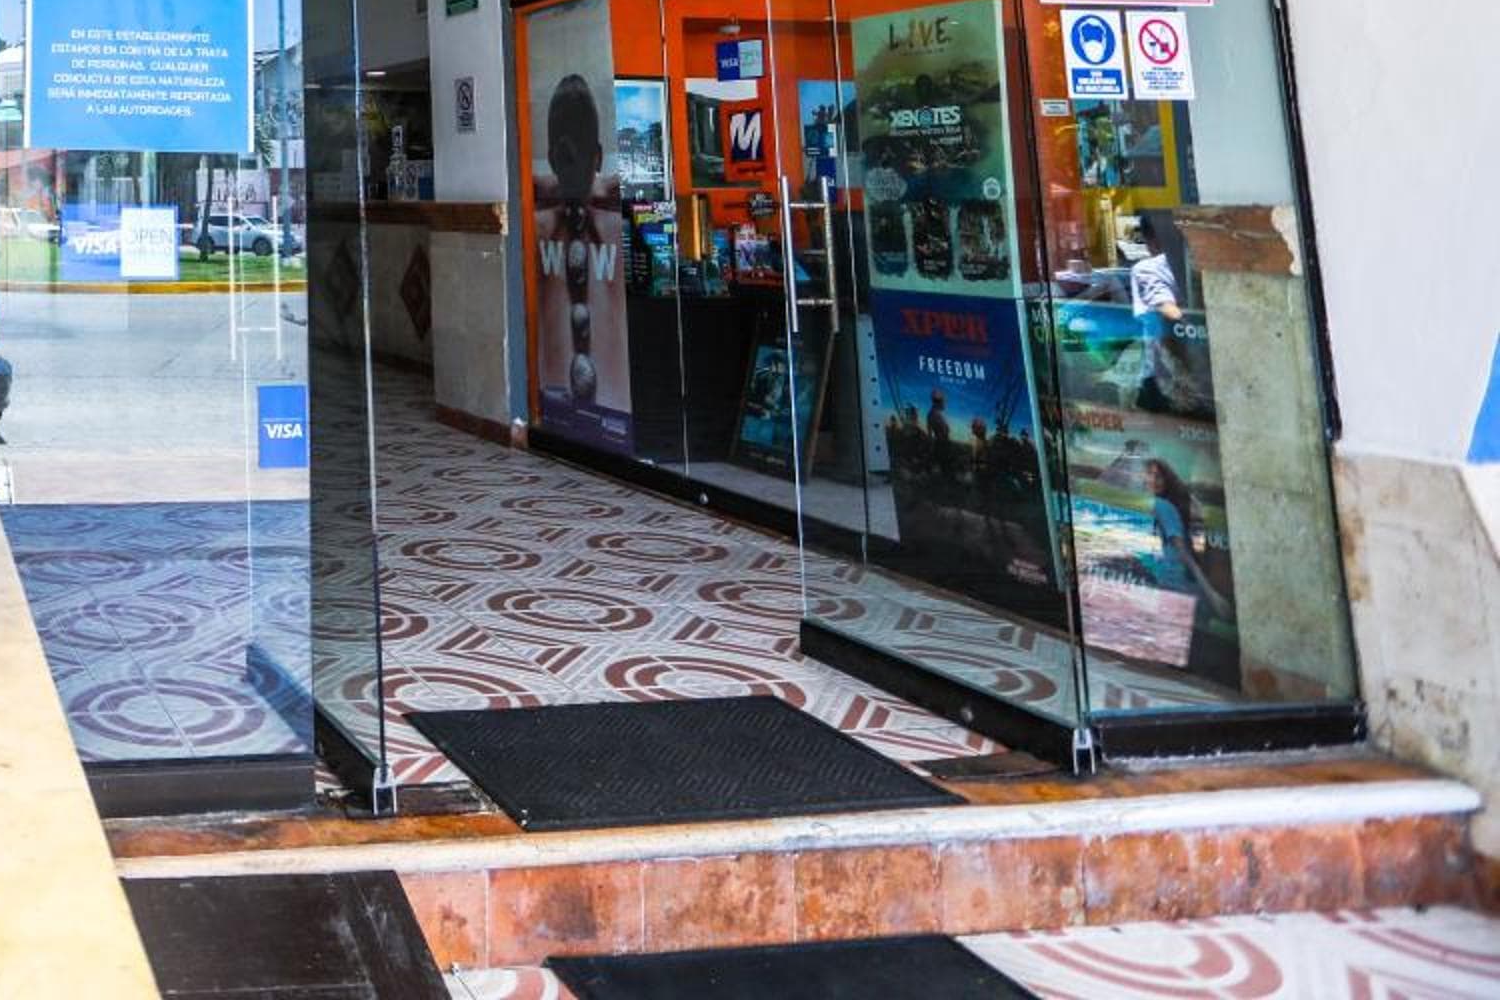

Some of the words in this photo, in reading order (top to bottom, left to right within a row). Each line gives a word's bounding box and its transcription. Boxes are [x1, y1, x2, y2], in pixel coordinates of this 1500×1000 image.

[115, 31, 211, 43] ESTABLECIMIENTO
[51, 43, 101, 55] ESTAMOS
[103, 45, 117, 55] EN
[119, 46, 161, 57] CONTRA
[163, 47, 180, 57] DE
[195, 47, 229, 58] TRATA
[71, 59, 86, 69] DE
[149, 61, 210, 73] CUALQUIER
[53, 73, 112, 85] CONDUCTA
[113, 75, 128, 85] DE
[158, 76, 225, 88] NATURALEZA
[76, 87, 169, 101] INMEDIATAMENTE
[170, 91, 232, 103] REPORTADA
[918, 355, 986, 381] FREEDOM
[264, 423, 303, 439] VISA
